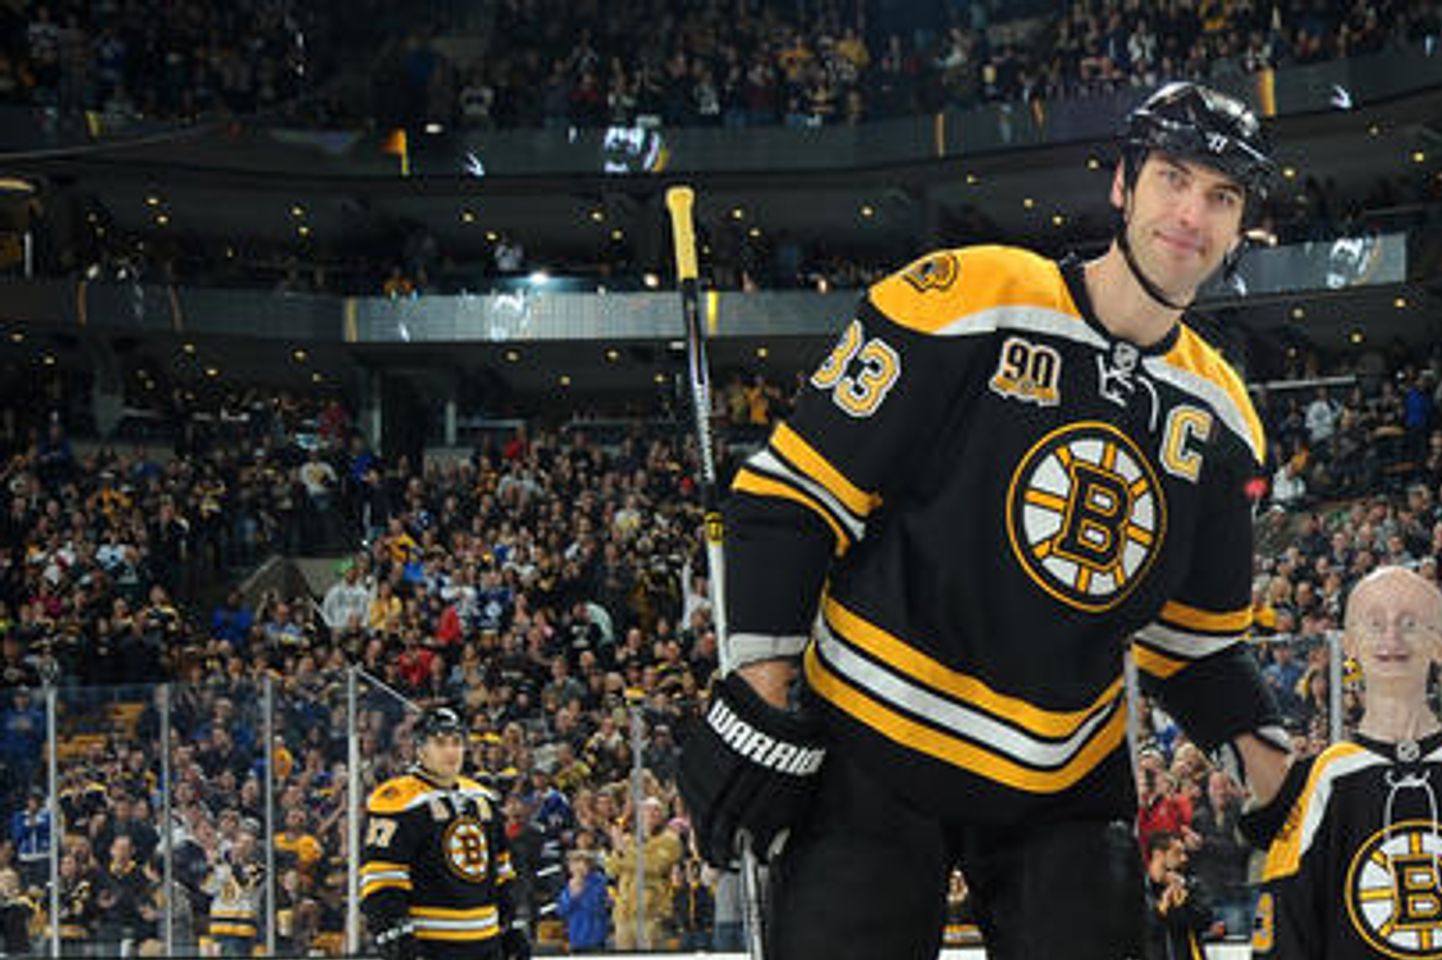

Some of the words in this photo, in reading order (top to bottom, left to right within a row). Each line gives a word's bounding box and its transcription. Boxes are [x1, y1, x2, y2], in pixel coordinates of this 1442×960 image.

[811, 319, 901, 418] 33
[1000, 337, 1058, 394] 90
[1159, 404, 1212, 484] C
[1051, 459, 1134, 571] B
